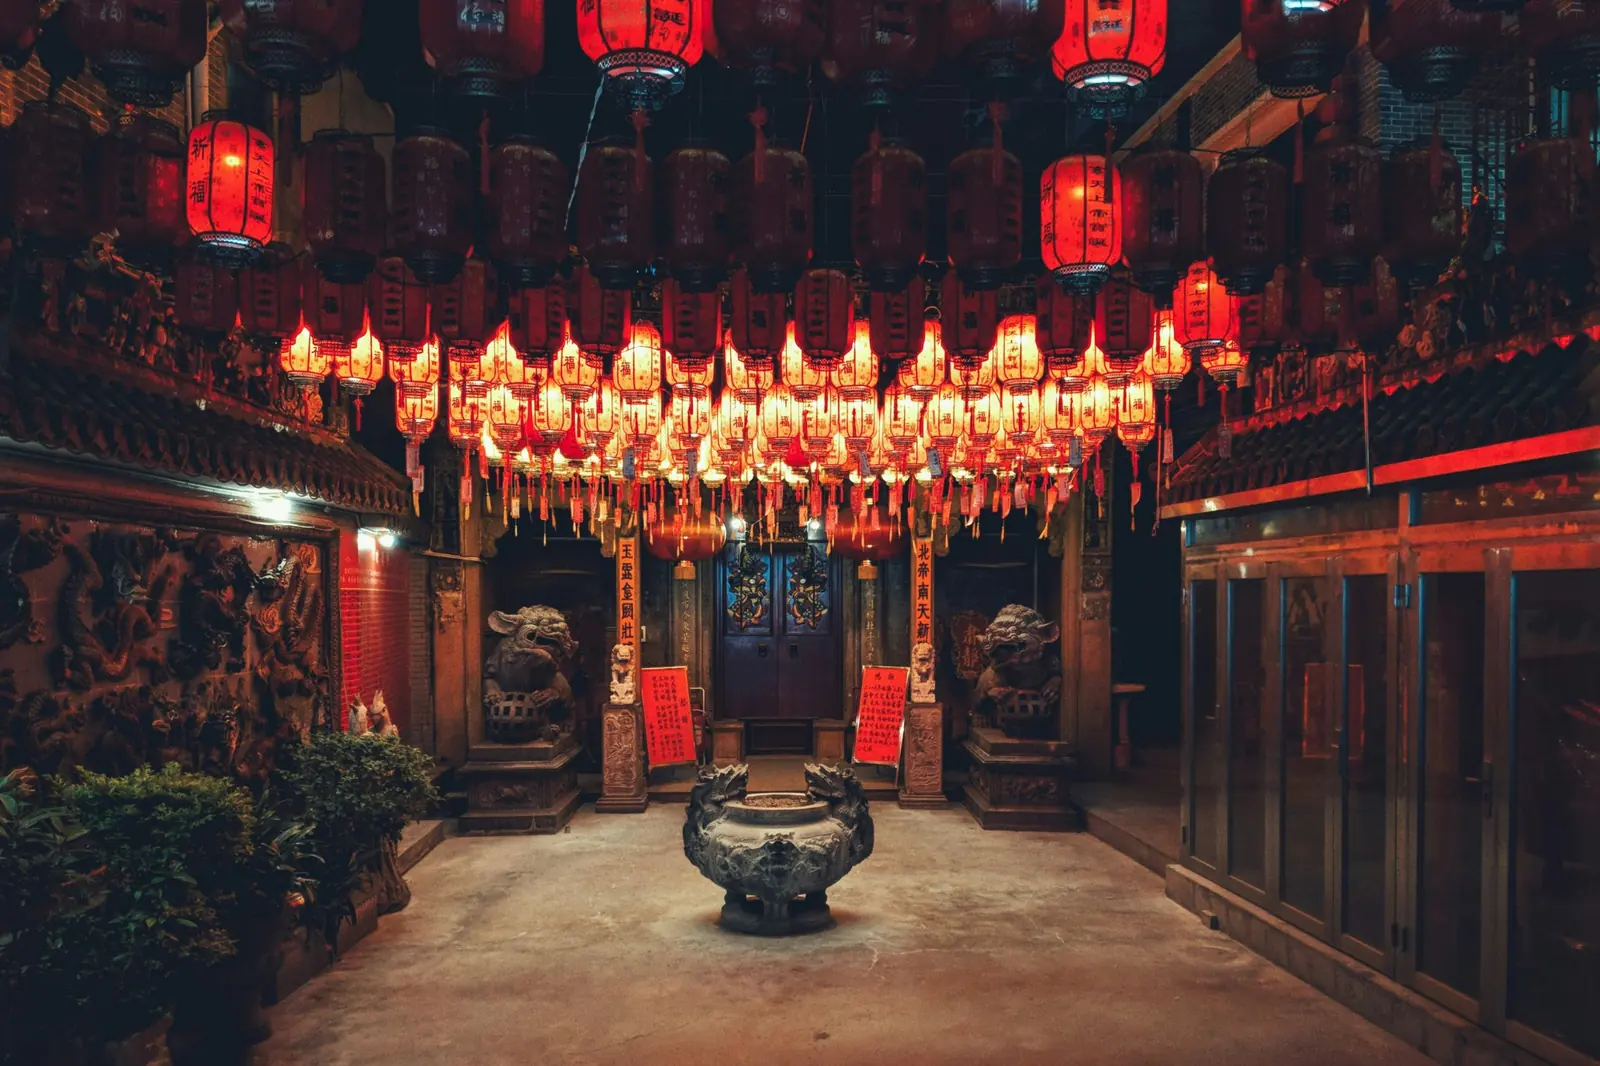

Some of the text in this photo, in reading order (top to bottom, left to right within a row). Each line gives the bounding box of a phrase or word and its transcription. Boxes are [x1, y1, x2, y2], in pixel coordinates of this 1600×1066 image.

[190, 136, 208, 205] 祈福
[917, 543, 930, 645] 北帝南天新
